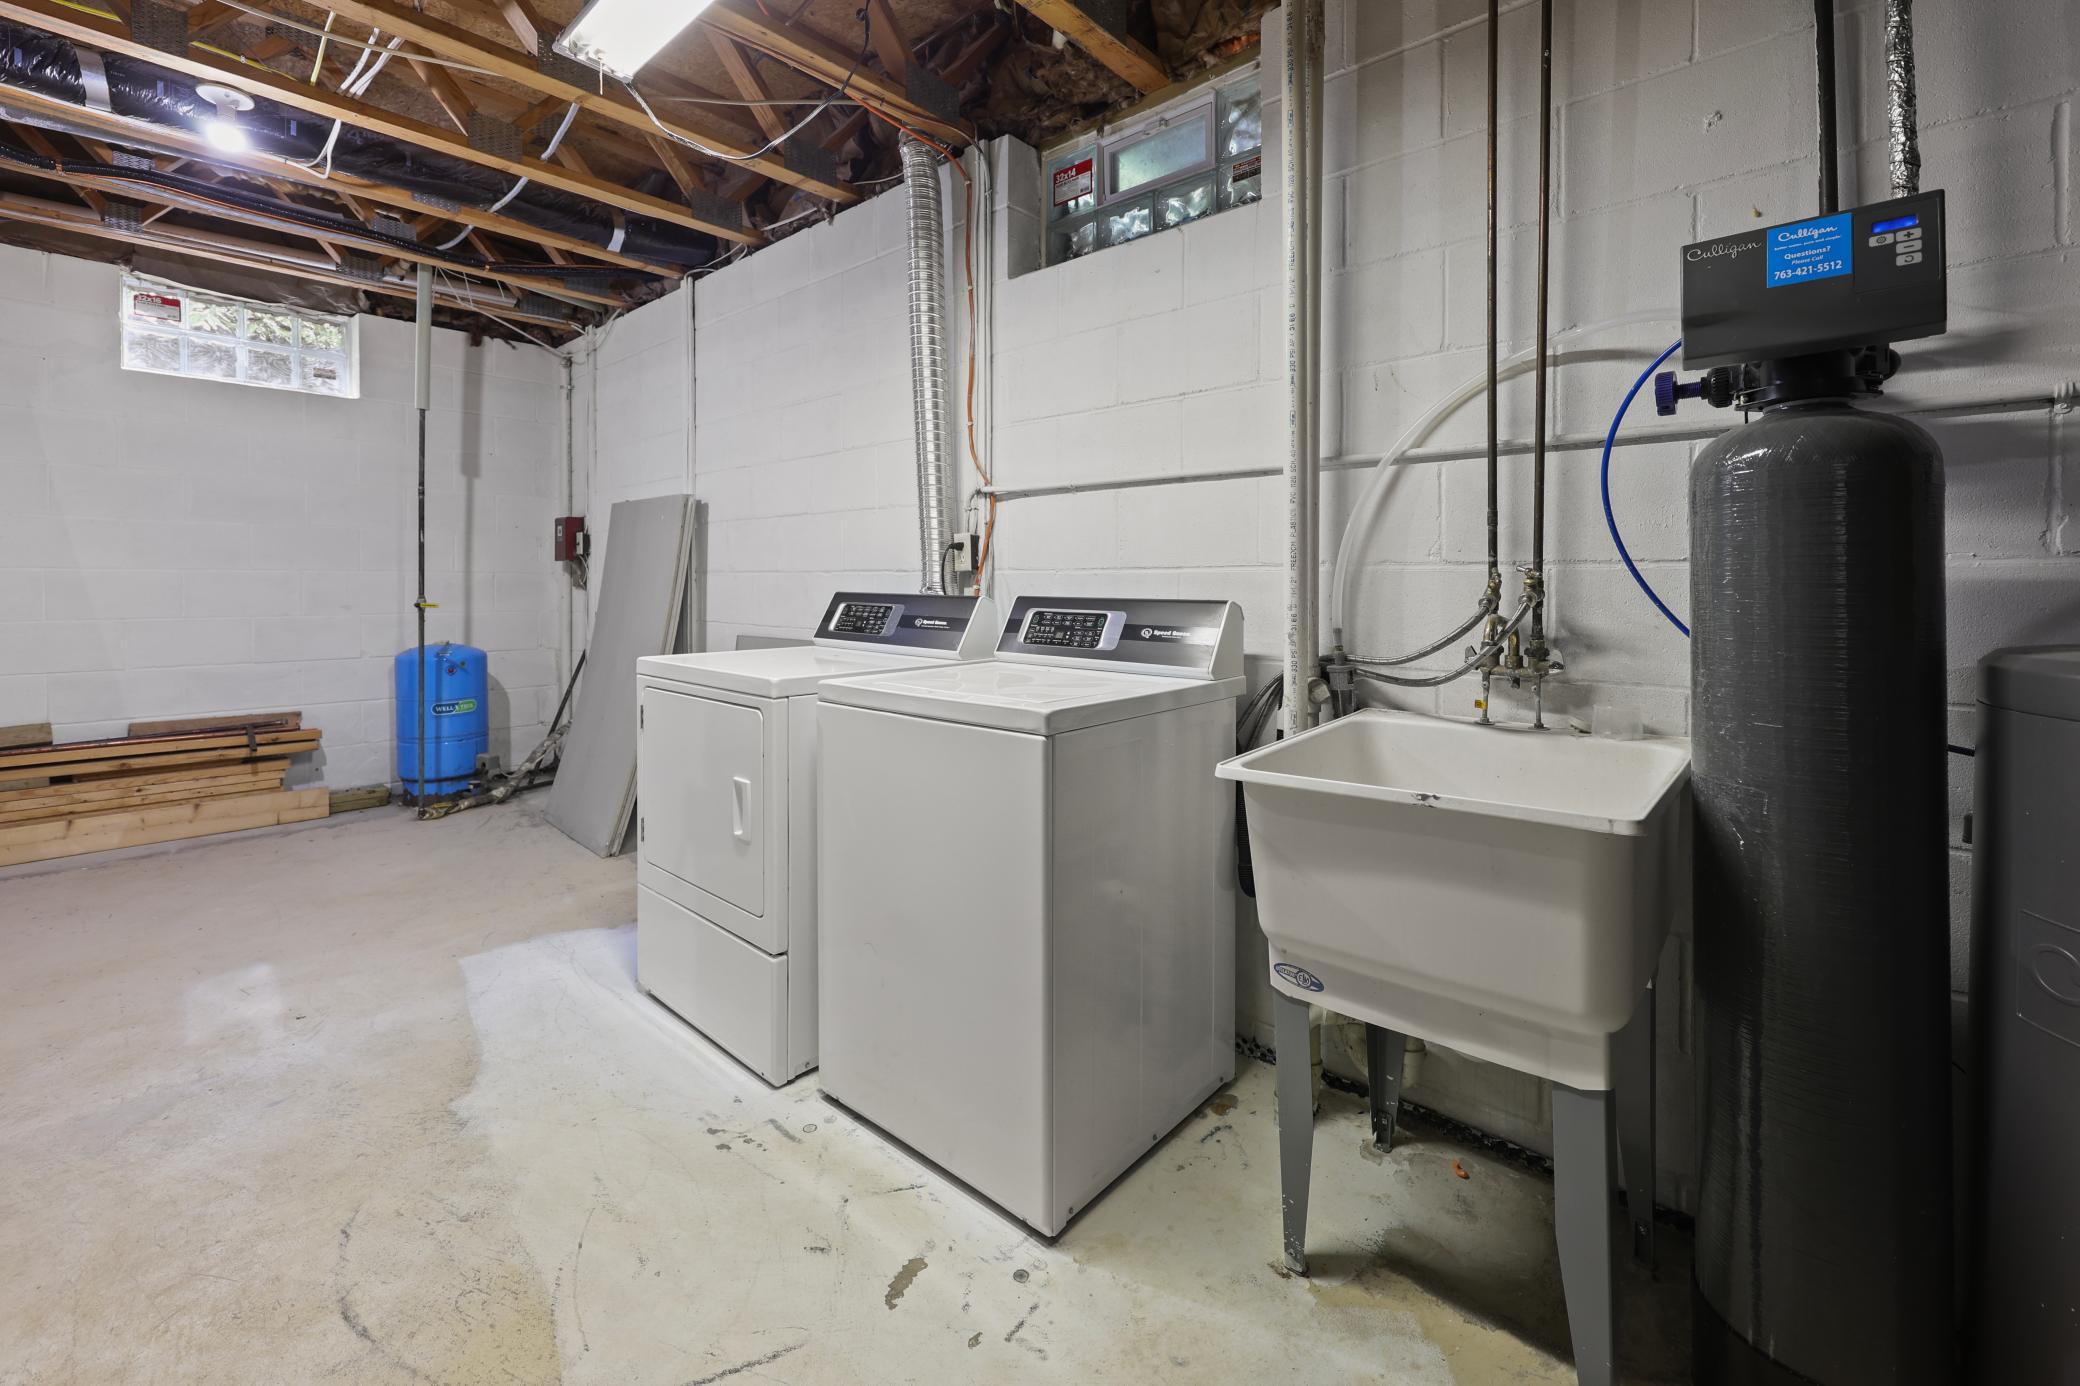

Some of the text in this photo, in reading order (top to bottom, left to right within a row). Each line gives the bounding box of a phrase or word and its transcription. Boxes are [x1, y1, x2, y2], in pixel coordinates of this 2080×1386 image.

[1055, 168, 1076, 183] 32x14
[1778, 226, 1838, 241] Culligan
[1687, 242, 1762, 261] Culligan
[1784, 245, 1831, 260] Questions?
[1774, 260, 1842, 279] 763-421-5512
[1289, 541, 1297, 571] FREEDOM
[1290, 660, 1298, 673] 330
